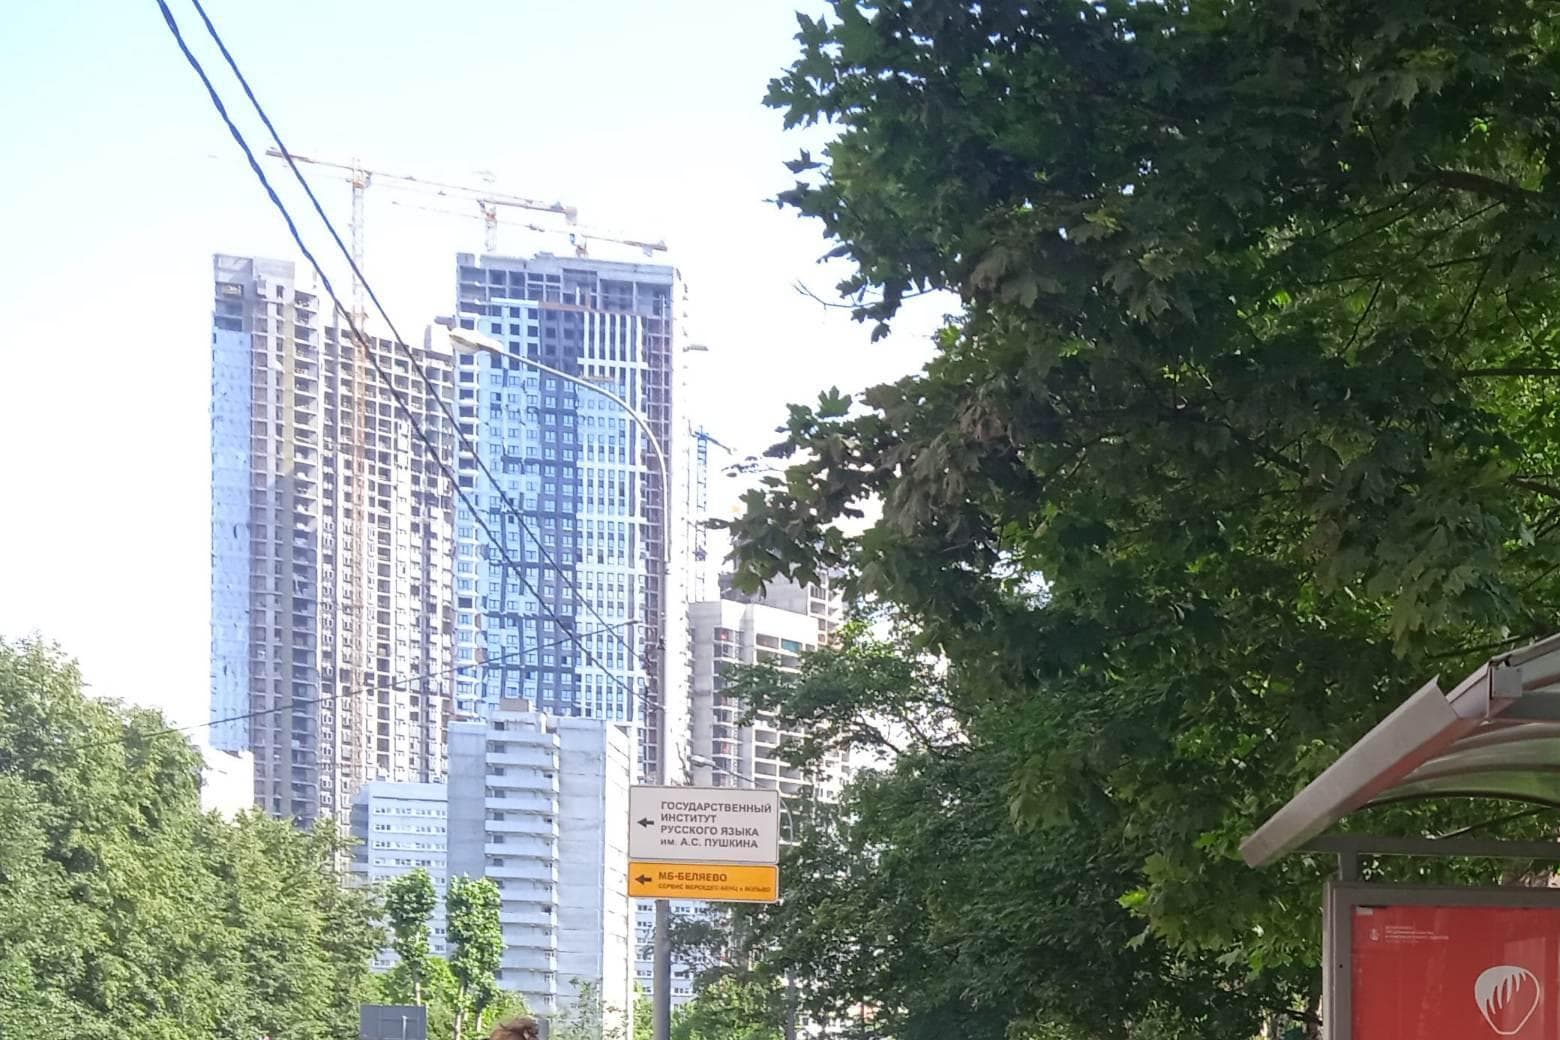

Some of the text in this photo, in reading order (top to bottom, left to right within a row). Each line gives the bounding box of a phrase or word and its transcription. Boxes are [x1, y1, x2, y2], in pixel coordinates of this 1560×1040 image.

[660, 801, 772, 813] ГОСУДАРСТВЕННЫЙ
[660, 813, 717, 823] ИНСТИТУТ
[660, 825, 759, 836] РУССКОГО ЯЗЫКА
[680, 838, 702, 847] А.С.
[704, 839, 758, 848] ПУШКИНА
[658, 872, 728, 882] МБ-БЕЛЯЕВО
